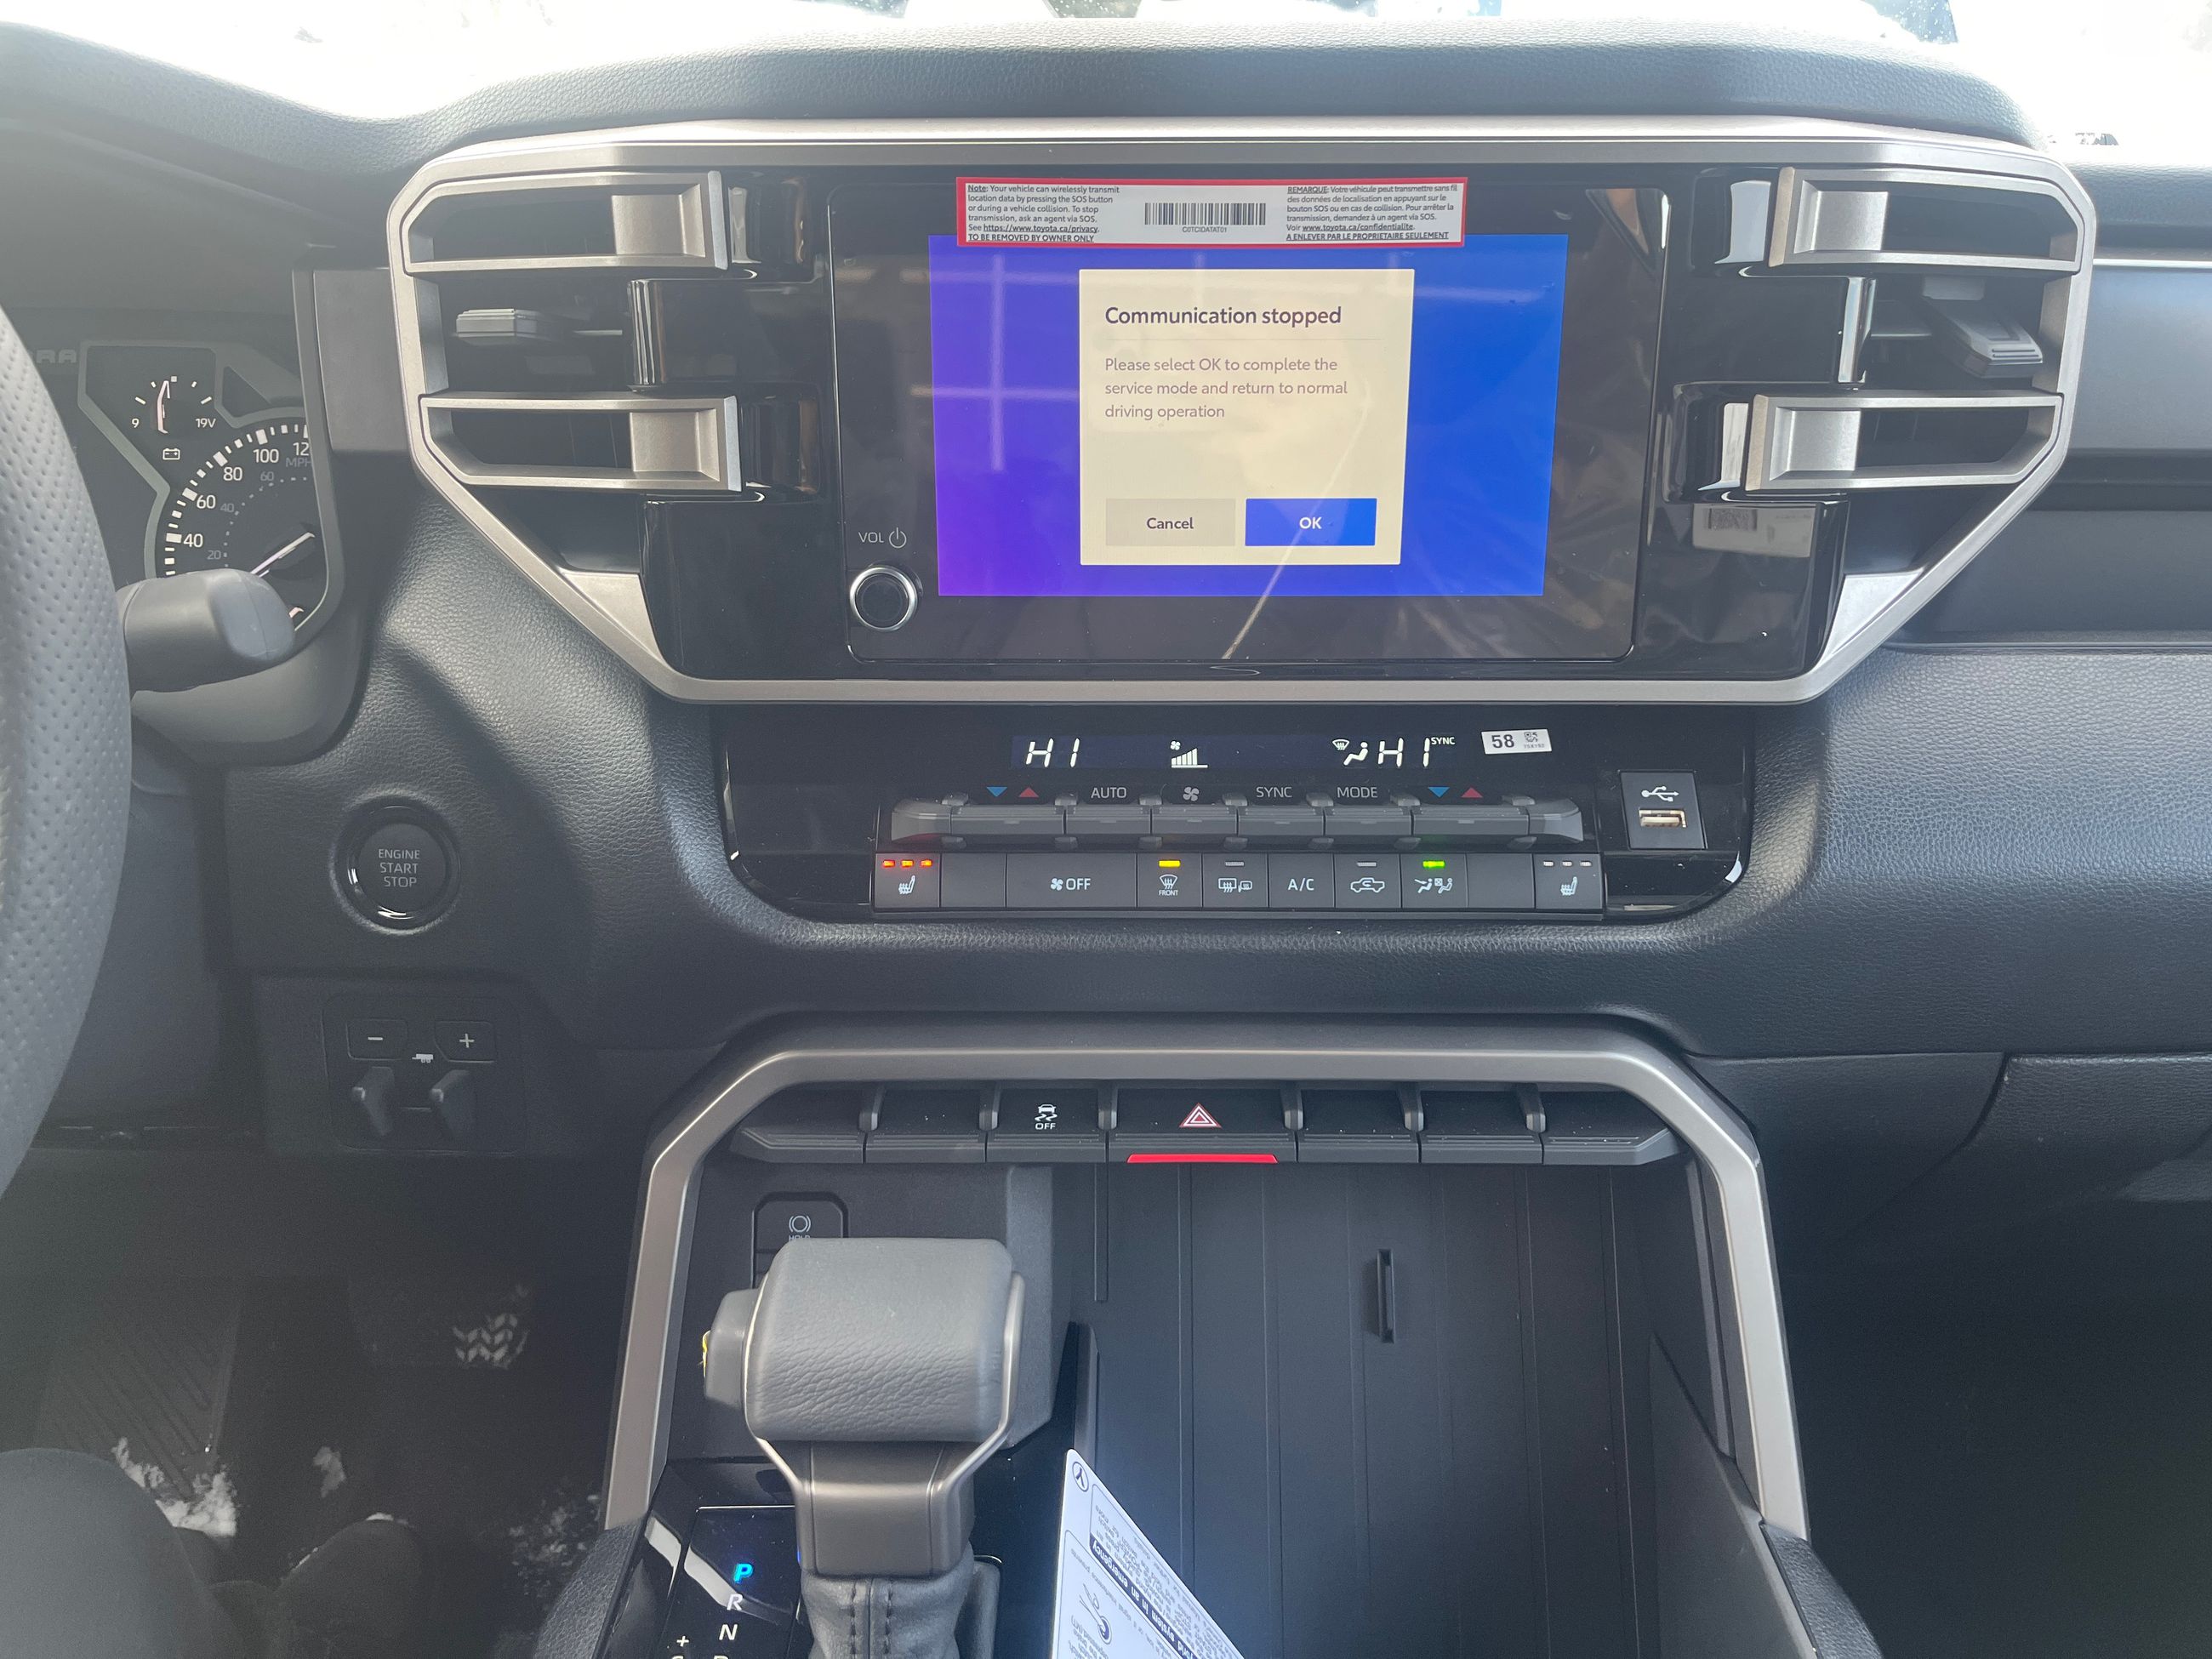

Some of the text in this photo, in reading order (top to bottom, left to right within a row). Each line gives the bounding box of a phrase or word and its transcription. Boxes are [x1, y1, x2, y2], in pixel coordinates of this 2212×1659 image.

[1052, 185, 1087, 194] wirelessly
[983, 225, 1099, 233] https://www.toyota.ca/privacy.
[1303, 223, 1415, 231] www.toyota.ca/confidentialite.
[1353, 232, 1403, 241] PROPRIETAIRE
[1105, 306, 1342, 328] Communication stopped
[1105, 358, 1337, 373] Please select OK to complete the
[1105, 381, 1348, 394] service mode and return to normal
[1105, 405, 1225, 420] driving operation
[132, 419, 139, 428] 9
[196, 418, 216, 429] 19V
[293, 443, 310, 456] 12
[253, 449, 279, 463] 100
[223, 467, 242, 481] 80
[259, 471, 274, 482] 60
[197, 495, 216, 509] 60
[220, 503, 235, 512] 40
[1146, 516, 1194, 530] Cancel
[1299, 516, 1322, 530] OK
[183, 534, 203, 547] 40
[858, 532, 884, 544] VOL
[207, 550, 221, 560] 20
[1431, 737, 1456, 745] SYNC
[1491, 734, 1514, 748] 58
[1091, 787, 1127, 798] AUTO
[1256, 787, 1292, 799] SYNC
[1337, 787, 1377, 798] MODE
[378, 849, 419, 859] ENGINE
[380, 862, 419, 874] START
[384, 876, 417, 887] STOP
[1066, 878, 1091, 890] OFF
[1288, 878, 1314, 891] A/C
[1092, 1537, 1127, 1589] emergency
[733, 1564, 754, 1583] P
[727, 1594, 743, 1611] R
[719, 1624, 738, 1640] N
